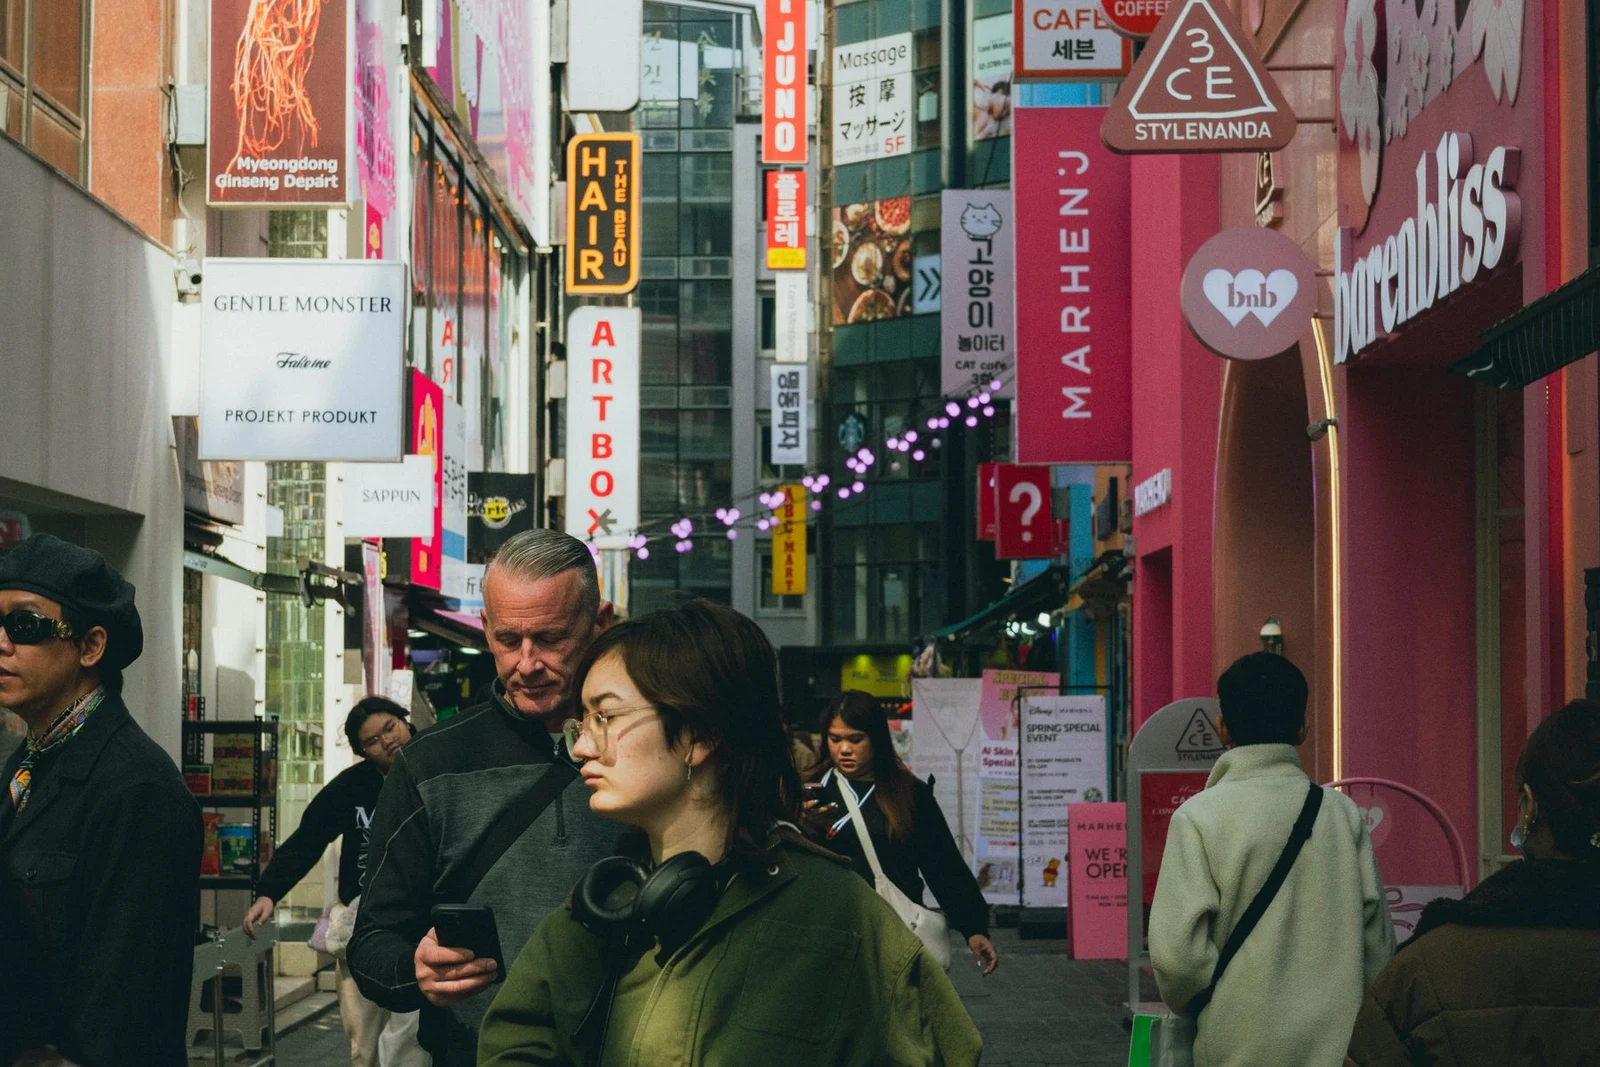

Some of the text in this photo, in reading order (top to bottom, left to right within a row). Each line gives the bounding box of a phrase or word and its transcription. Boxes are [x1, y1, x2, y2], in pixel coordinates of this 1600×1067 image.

[838, 43, 907, 71] Massage
[1052, 38, 1096, 61] 세븐
[775, 21, 796, 153] JUNO
[840, 110, 906, 141] マッサージ
[1134, 121, 1272, 141] STYLENANDA
[884, 135, 907, 154] 5F
[237, 156, 338, 172] Myeongdong
[215, 173, 339, 191] Ginseng Depart
[579, 146, 608, 280] HAIR
[613, 159, 628, 267] THE BEAU
[1333, 130, 1508, 366] barenbliss
[967, 237, 995, 329] 고양이
[214, 294, 392, 314] GENTLE MONSTER
[1227, 282, 1278, 309] bnb
[958, 334, 1005, 353] 놀이터
[955, 360, 976, 371] CAT
[225, 409, 378, 425] PROJEKT PRODUKT
[777, 371, 800, 450] 명동피자
[587, 321, 618, 536] ARTBOX
[362, 489, 422, 503] SAPPUN
[1026, 723, 1102, 734] SPRING SPECIAL
[1026, 733, 1058, 743] EVENT
[993, 746, 1014, 756] Skin
[982, 757, 1016, 768] Special
[1077, 822, 1128, 831] MARHE
[1085, 848, 1110, 861] WE
